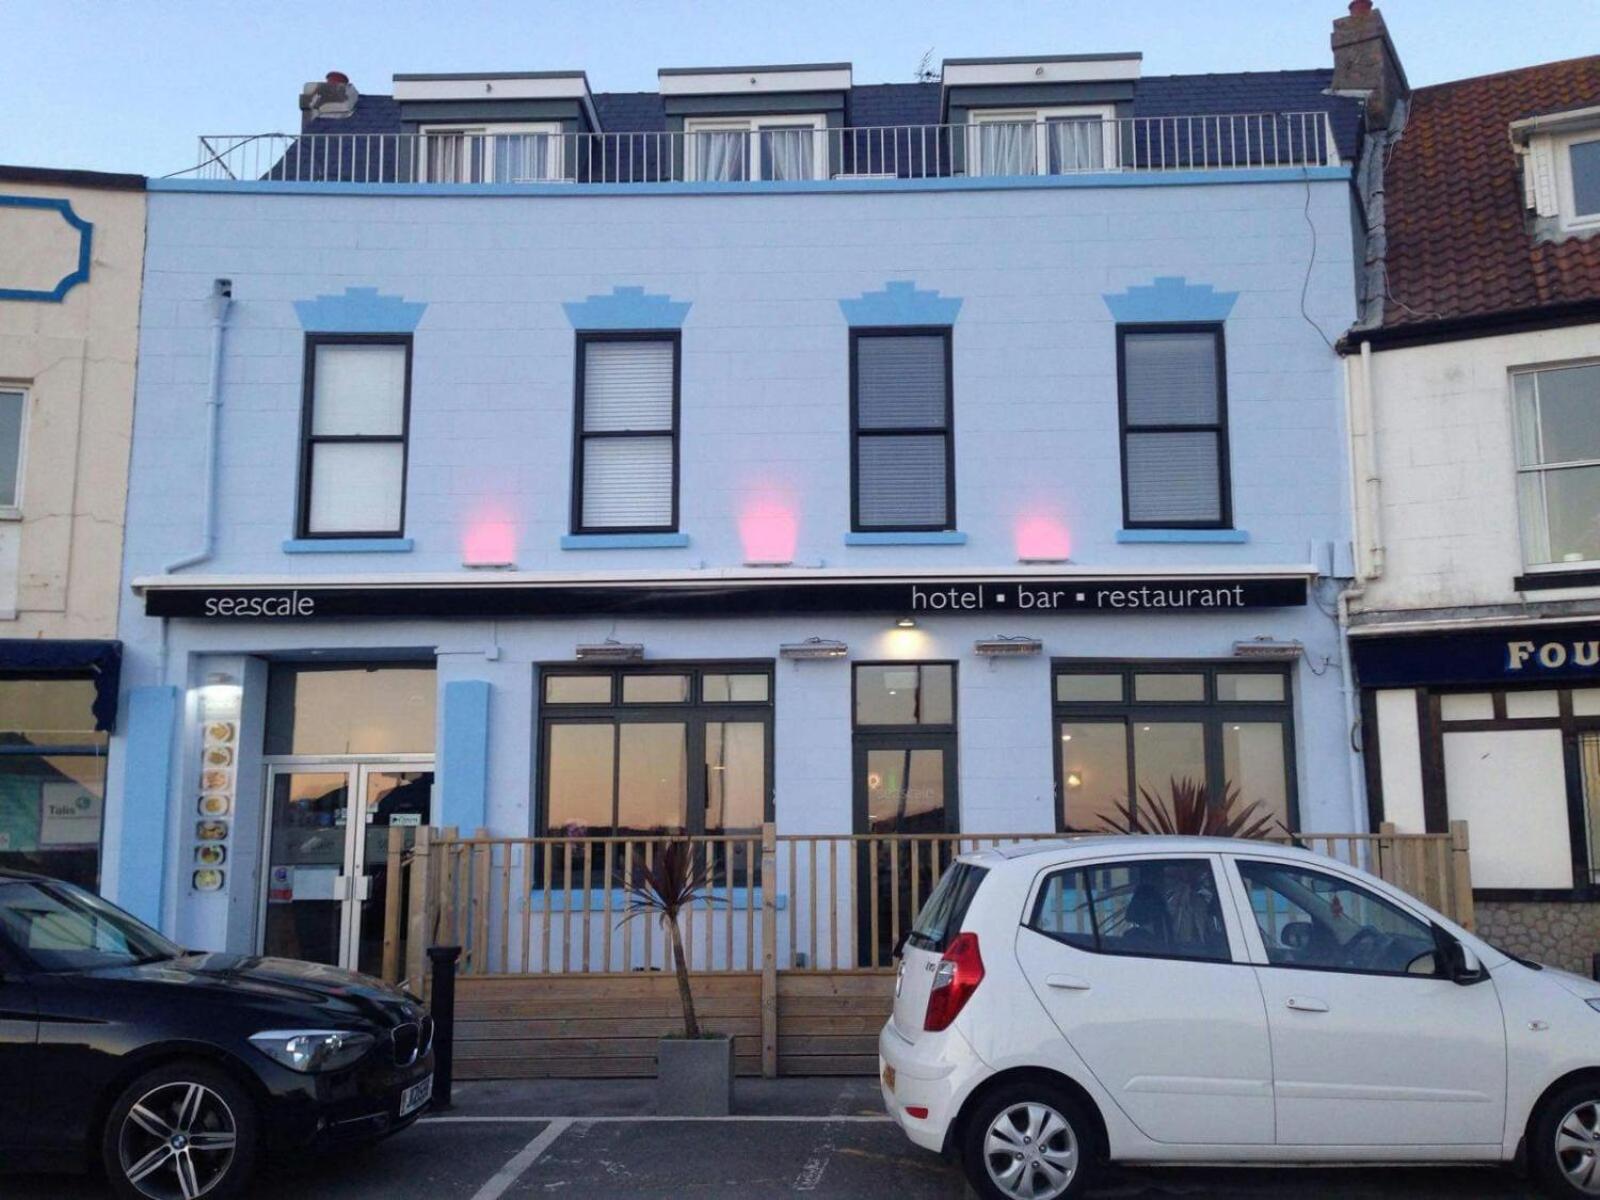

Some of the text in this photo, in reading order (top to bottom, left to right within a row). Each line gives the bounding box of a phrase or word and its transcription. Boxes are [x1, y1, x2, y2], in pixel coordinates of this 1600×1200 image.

[205, 590, 315, 615] seascale
[911, 584, 1245, 609] hotel bar restaurant
